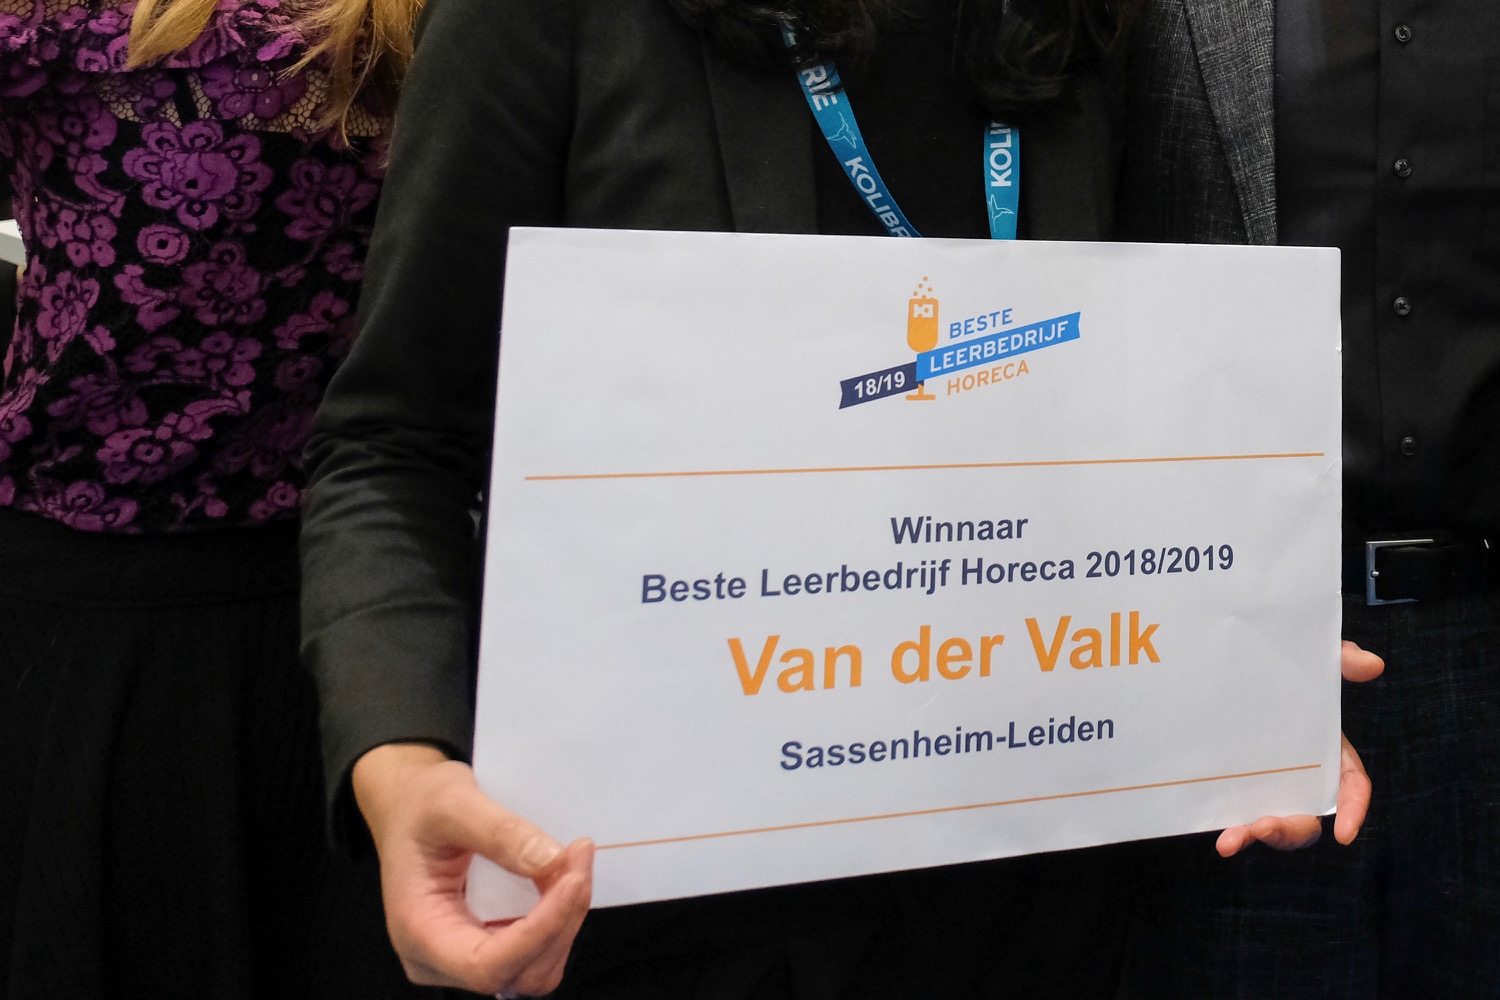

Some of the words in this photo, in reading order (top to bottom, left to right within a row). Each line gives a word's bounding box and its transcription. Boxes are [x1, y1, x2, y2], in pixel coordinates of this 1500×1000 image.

[990, 122, 1012, 187] KOLI
[845, 156, 912, 238] KOLIBR
[929, 320, 1069, 373] LEERBEDRIJF
[949, 307, 1013, 340] BESTE
[854, 370, 906, 399] 18/19
[947, 359, 1030, 396] HORECA
[890, 515, 1029, 545] Winnaar
[641, 571, 748, 604] Beste
[760, 558, 951, 597] Leerbedrijf
[961, 556, 1075, 587] Horeca
[1085, 544, 1234, 579] 2018/2019
[727, 634, 863, 696] Van
[890, 624, 1006, 685] der
[1024, 610, 1161, 673] Valk
[780, 715, 1115, 771] Sassenheim-Leiden
